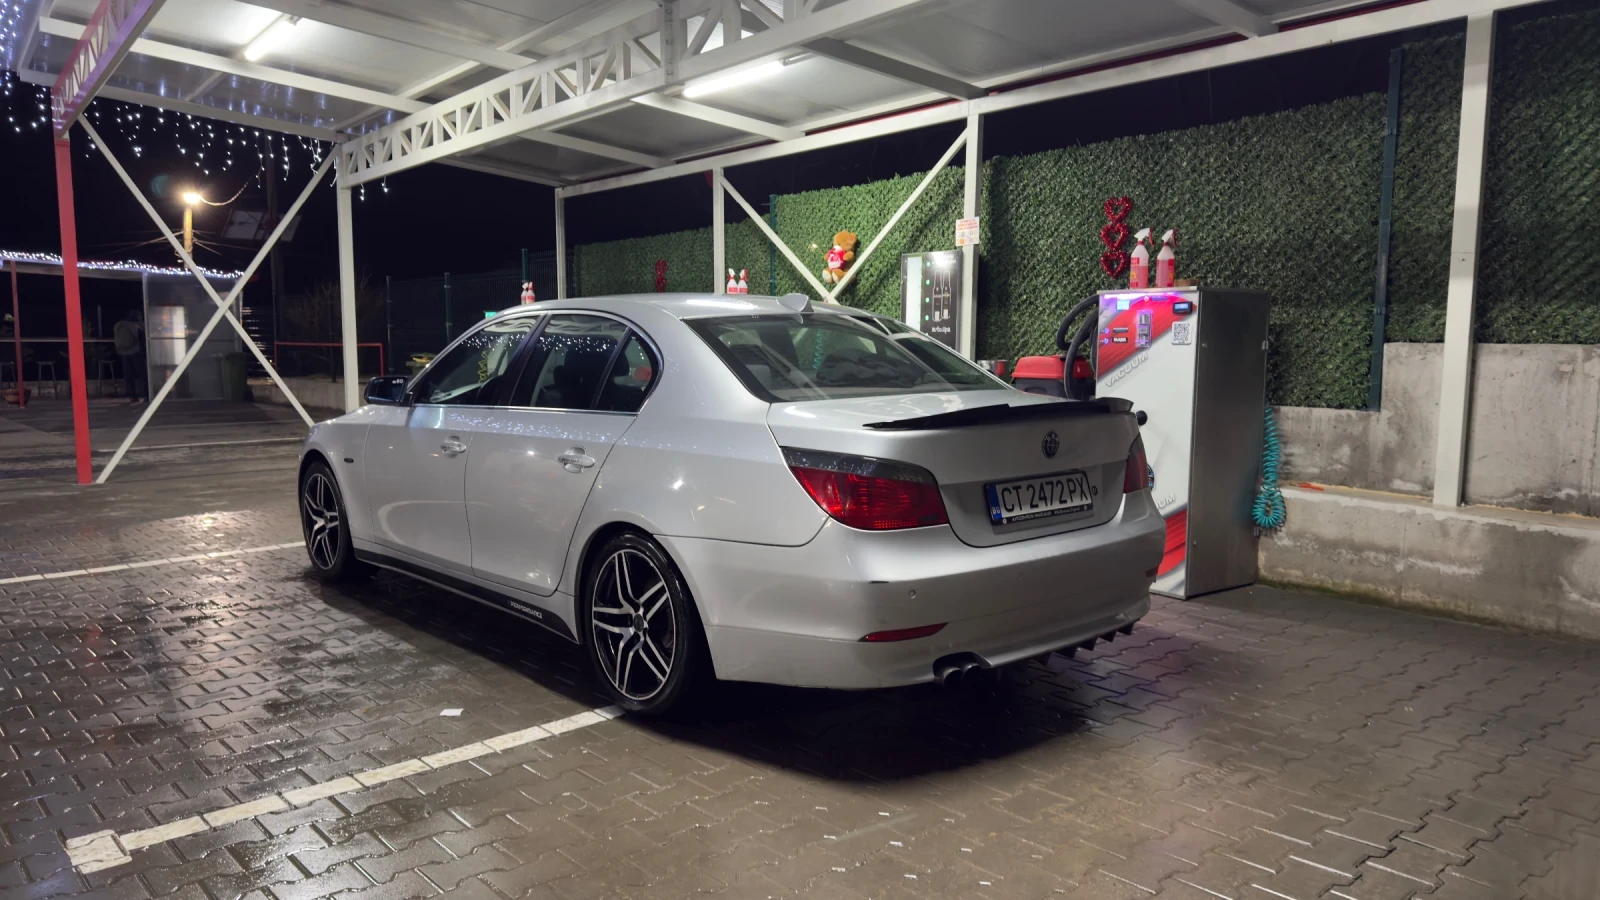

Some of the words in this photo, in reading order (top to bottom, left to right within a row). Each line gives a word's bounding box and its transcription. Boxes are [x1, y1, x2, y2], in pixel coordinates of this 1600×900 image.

[1105, 352, 1148, 387] VACUUM
[1001, 485, 1023, 512] CT
[1026, 480, 1068, 509] 2472
[1066, 477, 1088, 503] PX
